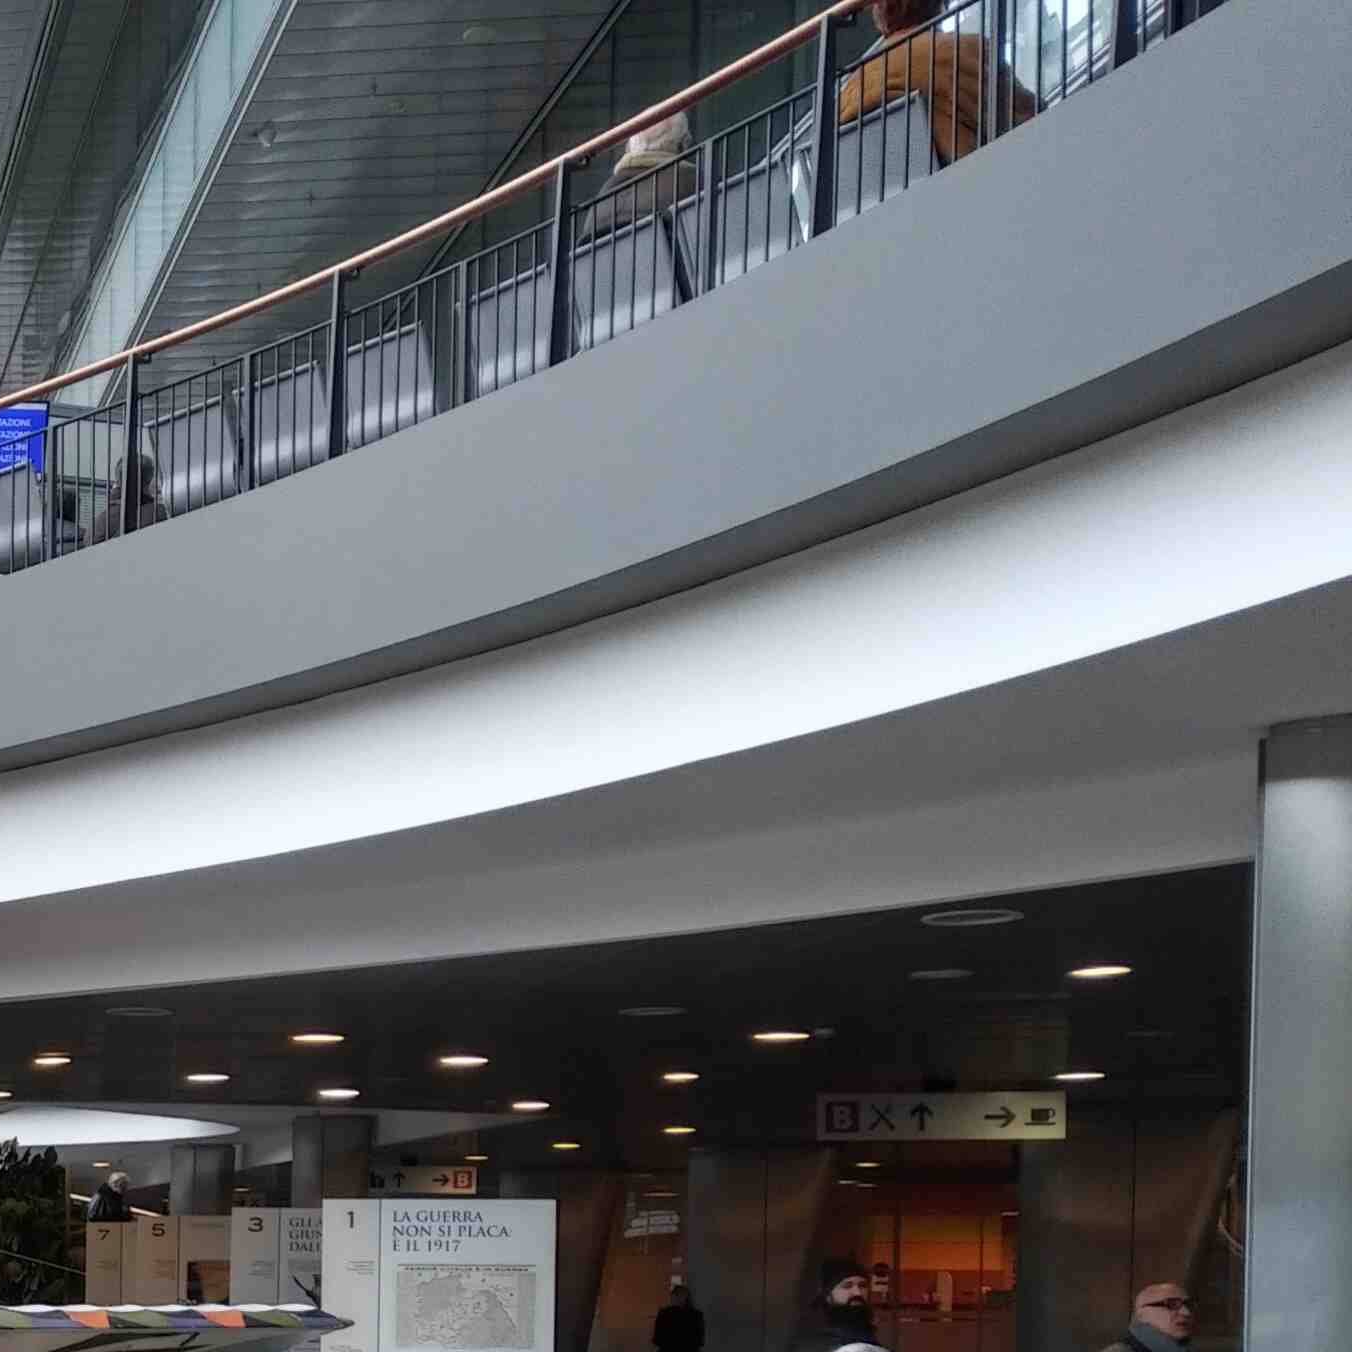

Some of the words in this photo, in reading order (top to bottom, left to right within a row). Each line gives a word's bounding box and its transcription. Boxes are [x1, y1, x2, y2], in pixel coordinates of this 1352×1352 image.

[831, 1106, 854, 1129] B
[346, 1211, 356, 1229] 1
[393, 1210, 412, 1223] LA
[416, 1210, 484, 1223] GUERRA
[151, 1223, 166, 1237] 5
[248, 1217, 264, 1232] 3
[99, 1229, 111, 1240] 7
[392, 1225, 432, 1238] NON
[438, 1225, 452, 1238] SI
[458, 1225, 511, 1238] PLACA
[392, 1240, 400, 1252] E
[406, 1240, 420, 1252] IL
[427, 1240, 462, 1252] 1917
